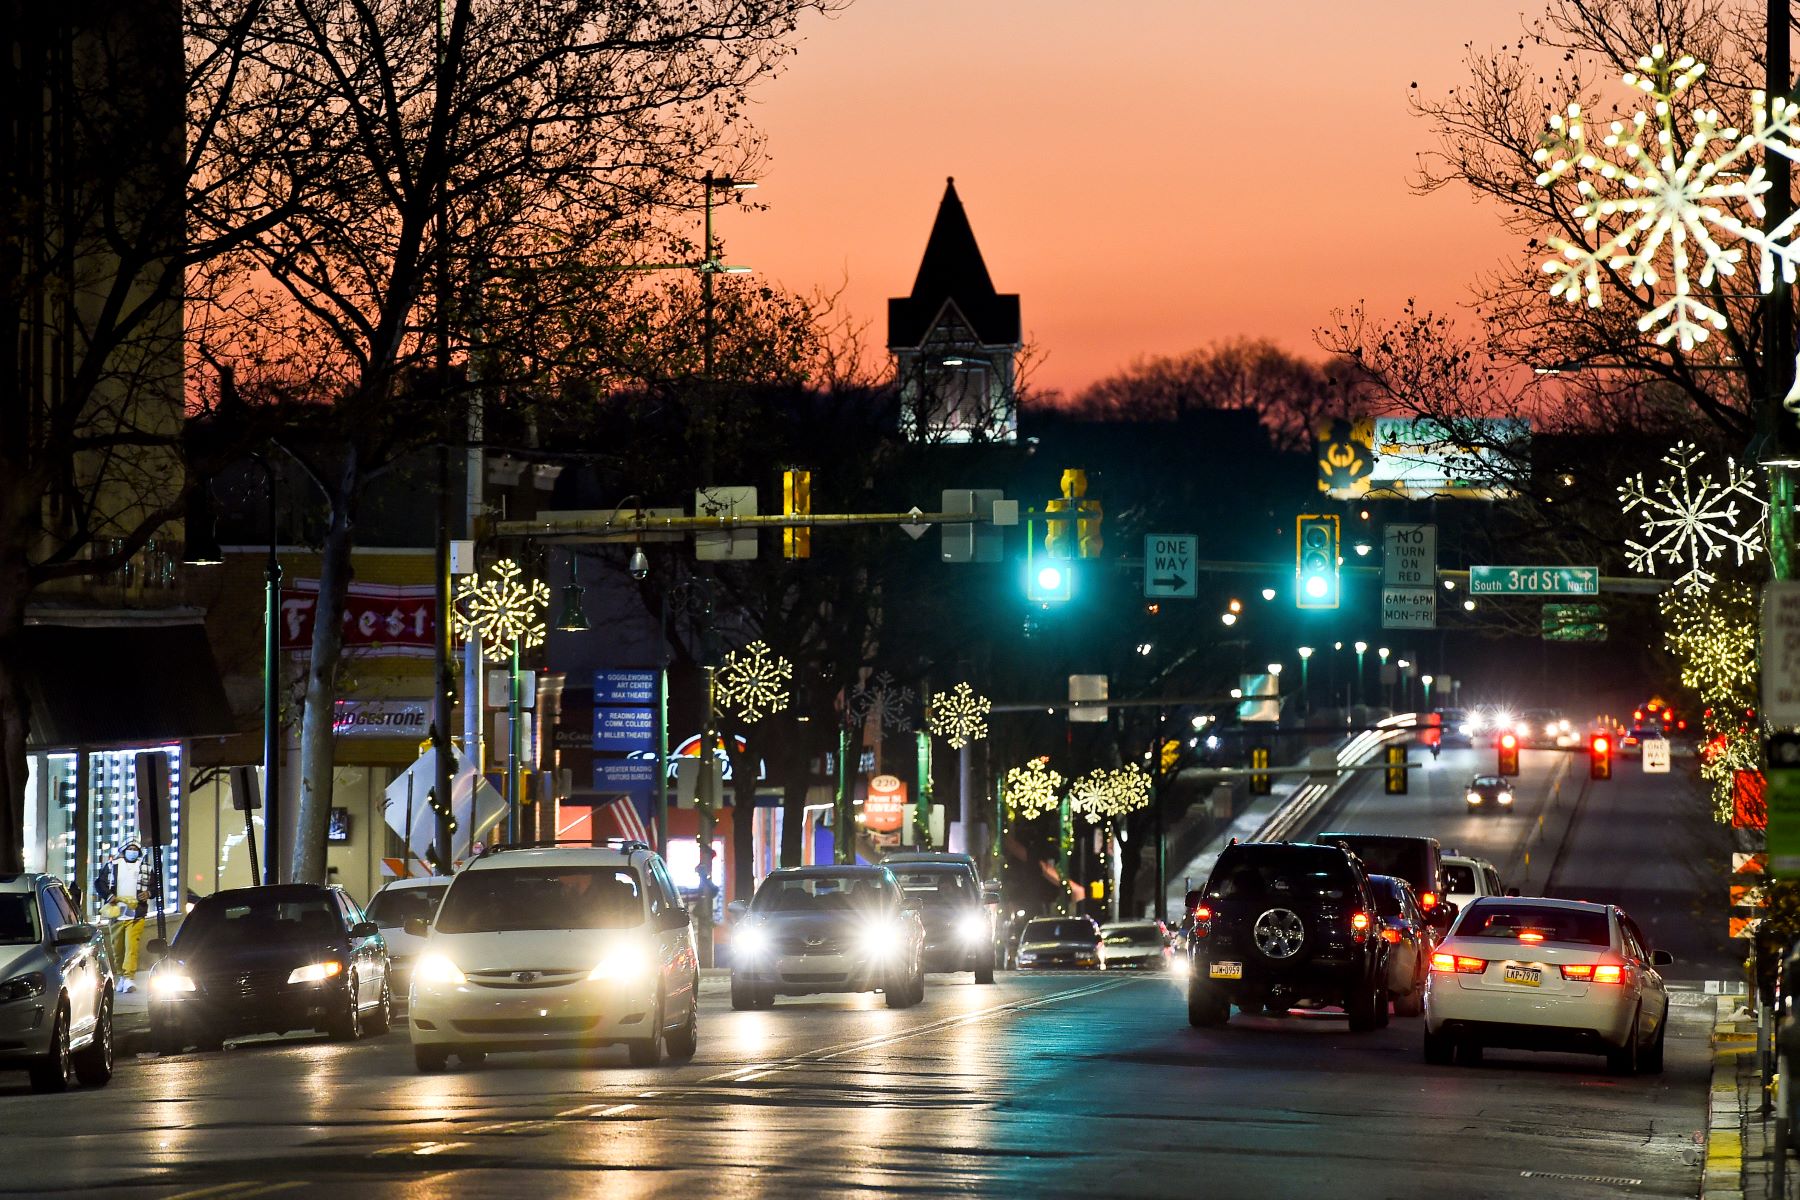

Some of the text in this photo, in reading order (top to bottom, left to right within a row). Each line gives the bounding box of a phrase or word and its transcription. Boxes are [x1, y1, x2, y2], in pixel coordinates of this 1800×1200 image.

[1397, 531, 1423, 544] NO
[1156, 541, 1187, 554] ONE
[1395, 547, 1424, 557] TURN
[1155, 557, 1187, 570] WAY
[1401, 560, 1418, 569] ON
[1399, 572, 1421, 581] RED
[1474, 571, 1594, 591] South 3rd St North
[1385, 595, 1433, 605] 6AM-6PM
[1385, 610, 1433, 620] MON-FRI
[875, 779, 897, 787] 220
